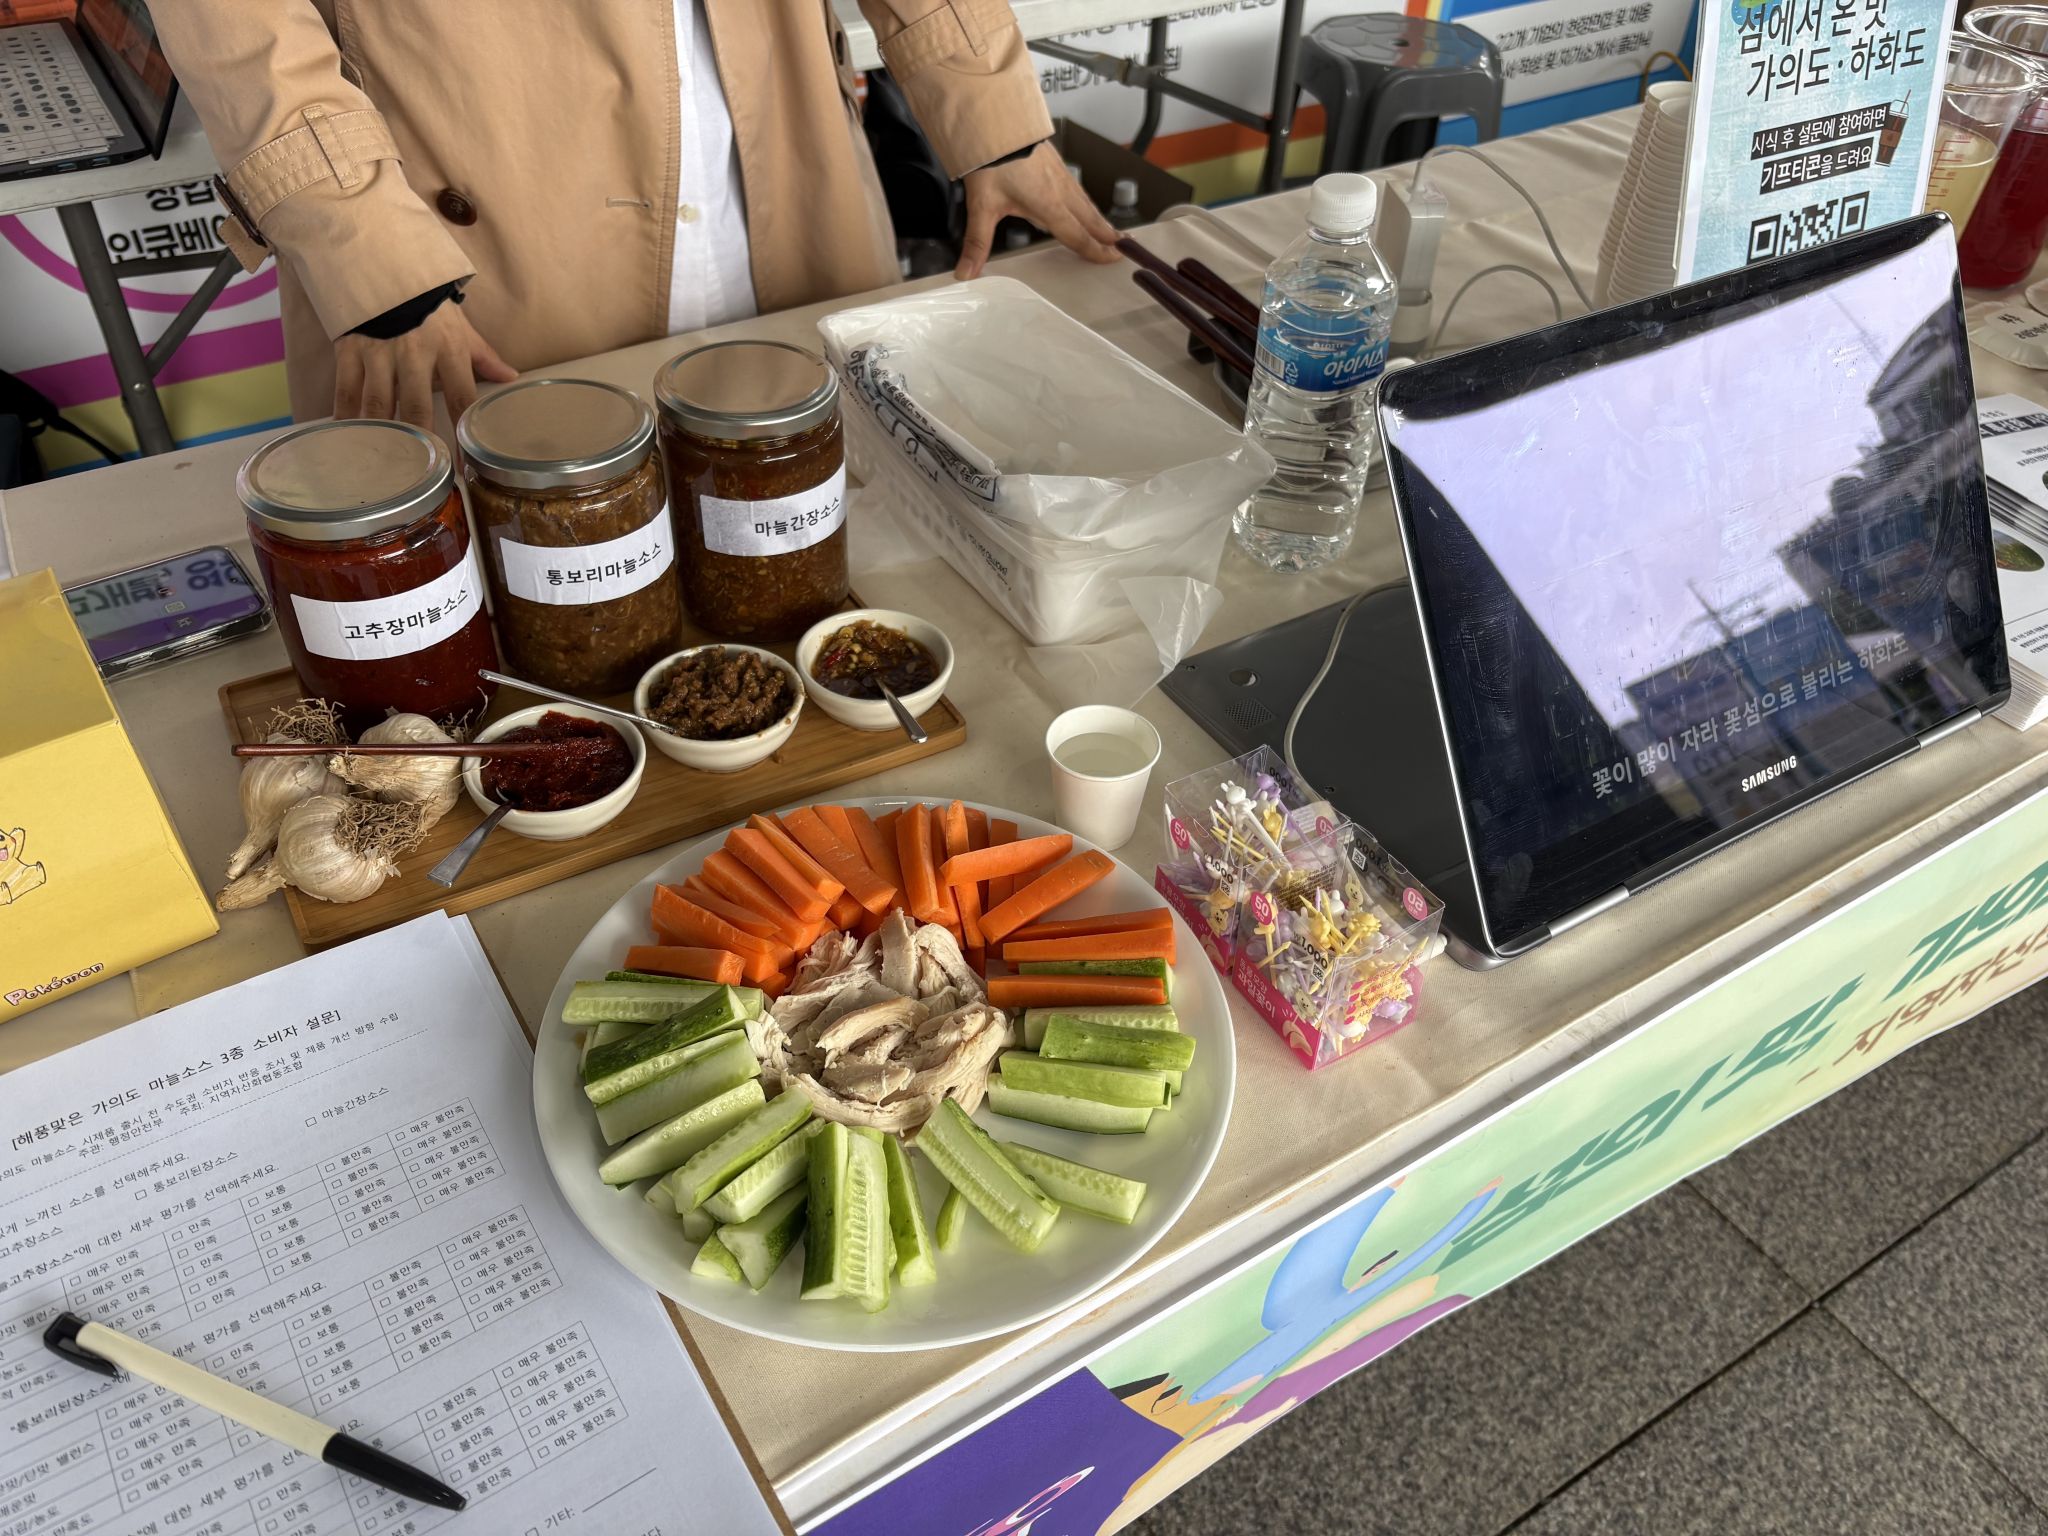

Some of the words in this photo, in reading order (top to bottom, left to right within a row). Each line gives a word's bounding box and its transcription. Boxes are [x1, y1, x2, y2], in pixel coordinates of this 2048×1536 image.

[1738, 0, 1824, 55] 섬에서
[1752, 129, 1779, 154] 시식
[1782, 127, 1794, 149] 후
[1798, 117, 1835, 144] 설문에
[1839, 106, 1887, 137] 참여하면
[1761, 155, 1833, 189] 기프티콘을
[1835, 145, 1872, 171] 드려요
[1324, 347, 1384, 378] 아이시스
[754, 496, 842, 538] 마늘간장소스
[546, 541, 663, 585] 통보리마늘소스
[344, 587, 469, 640] 고추장마늘소스
[1592, 760, 1632, 799] 꽃이
[1636, 737, 1677, 777] 많이
[1680, 717, 1718, 752] 자라
[1724, 682, 1797, 737] 꽃섬으로
[1801, 661, 1853, 702] 불리는
[1857, 632, 1909, 670] 하화도
[1741, 755, 1797, 793] SAMSUNG
[1173, 826, 1188, 842] 50
[1254, 896, 1269, 916] 50
[1880, 861, 2048, 1003] 가의
[4, 963, 104, 1006] Pokémon
[1832, 924, 2048, 1067] 지역자산
[31, 1144, 77, 1167] 마늘소스
[83, 1127, 115, 1146] 시제품
[120, 1115, 143, 1131] 출시
[148, 1108, 159, 1119] 전
[164, 1093, 197, 1112] 수도권
[202, 1078, 234, 1097] 소비자
[238, 1066, 260, 1082] 반응
[266, 1057, 286, 1072] 조사
[290, 1050, 301, 1061] 및
[306, 1041, 327, 1055] 제품
[331, 1031, 350, 1045] 개선
[354, 1022, 376, 1035] 방향
[379, 1011, 400, 1026] 수립
[78, 1142, 104, 1159] 주관:
[108, 1117, 164, 1148] 행정안전부
[179, 1101, 206, 1117] 주최:
[209, 1060, 304, 1104] 지역자산화협동조합
[92, 1088, 142, 1116] 가의도
[149, 1060, 214, 1092] 마늘소스
[220, 1046, 245, 1065] 3종
[253, 1025, 298, 1051] 소비자
[69, 1184, 106, 1209] 소스를
[112, 1151, 190, 1190] 선택해주세요.
[153, 1150, 240, 1194] 통보리된장소스
[321, 1085, 390, 1120] 마늘간장소스
[97, 1229, 123, 1248] 대한
[129, 1216, 154, 1234] 세부
[159, 1196, 197, 1221] 평가를
[203, 1162, 280, 1202] 선택해주세요.
[116, 1248, 140, 1266] 만족
[188, 1217, 212, 1233] 만족
[264, 1183, 286, 1200] 보통
[340, 1146, 373, 1166] 불만족
[435, 1104, 465, 1124] 불만족
[121, 1266, 145, 1284] 만족
[194, 1234, 218, 1251] 만족
[270, 1200, 293, 1216] 보통
[346, 1161, 379, 1182] 불만족
[442, 1119, 472, 1139] 불만족
[126, 1284, 151, 1302] 만족
[200, 1252, 223, 1269] 만족
[277, 1216, 299, 1234] 보통
[353, 1177, 386, 1198] 불만족
[449, 1134, 480, 1155] 불만족
[132, 1302, 156, 1321] 만족
[205, 1269, 230, 1287] 만족
[283, 1234, 306, 1250] 보통
[360, 1193, 393, 1214] 불만족
[456, 1150, 488, 1170] 불만족
[137, 1322, 162, 1339] 만족
[211, 1287, 235, 1304] 만족
[290, 1251, 313, 1267] 보통
[367, 1210, 401, 1231] 불만족
[464, 1165, 495, 1186] 불만족
[203, 1319, 241, 1345] 평가를
[248, 1281, 327, 1325] 선택해주세요.
[230, 1342, 254, 1360] 만족
[310, 1304, 333, 1321] 보통
[389, 1260, 422, 1283] 불만족
[487, 1213, 519, 1234] 불만족
[236, 1360, 261, 1378] 만족
[316, 1321, 340, 1339] 보통
[396, 1277, 430, 1300] 불만족
[495, 1229, 527, 1250] 불만족
[323, 1340, 347, 1358] 보통
[403, 1294, 437, 1317] 불만족
[503, 1245, 535, 1266] 불만족
[330, 1358, 354, 1377] 보통
[411, 1311, 445, 1335] 불만족
[511, 1261, 543, 1283] 불만족
[337, 1378, 361, 1397] 보통
[418, 1329, 453, 1354] 불만족
[519, 1278, 551, 1301] 불만족
[442, 1386, 478, 1412] 불만족
[545, 1331, 578, 1355] 불만족
[450, 1405, 486, 1432] 불만족
[554, 1349, 588, 1374] 불만족
[458, 1425, 495, 1453] 불만족
[563, 1368, 597, 1393] 불만족
[467, 1445, 504, 1473] 불만족
[572, 1387, 607, 1413] 불만족
[581, 1407, 616, 1433] 불만족
[163, 1503, 193, 1526] 대한
[200, 1486, 227, 1507] 세부
[234, 1462, 274, 1490] 평가를
[544, 1507, 576, 1529] 기타:
